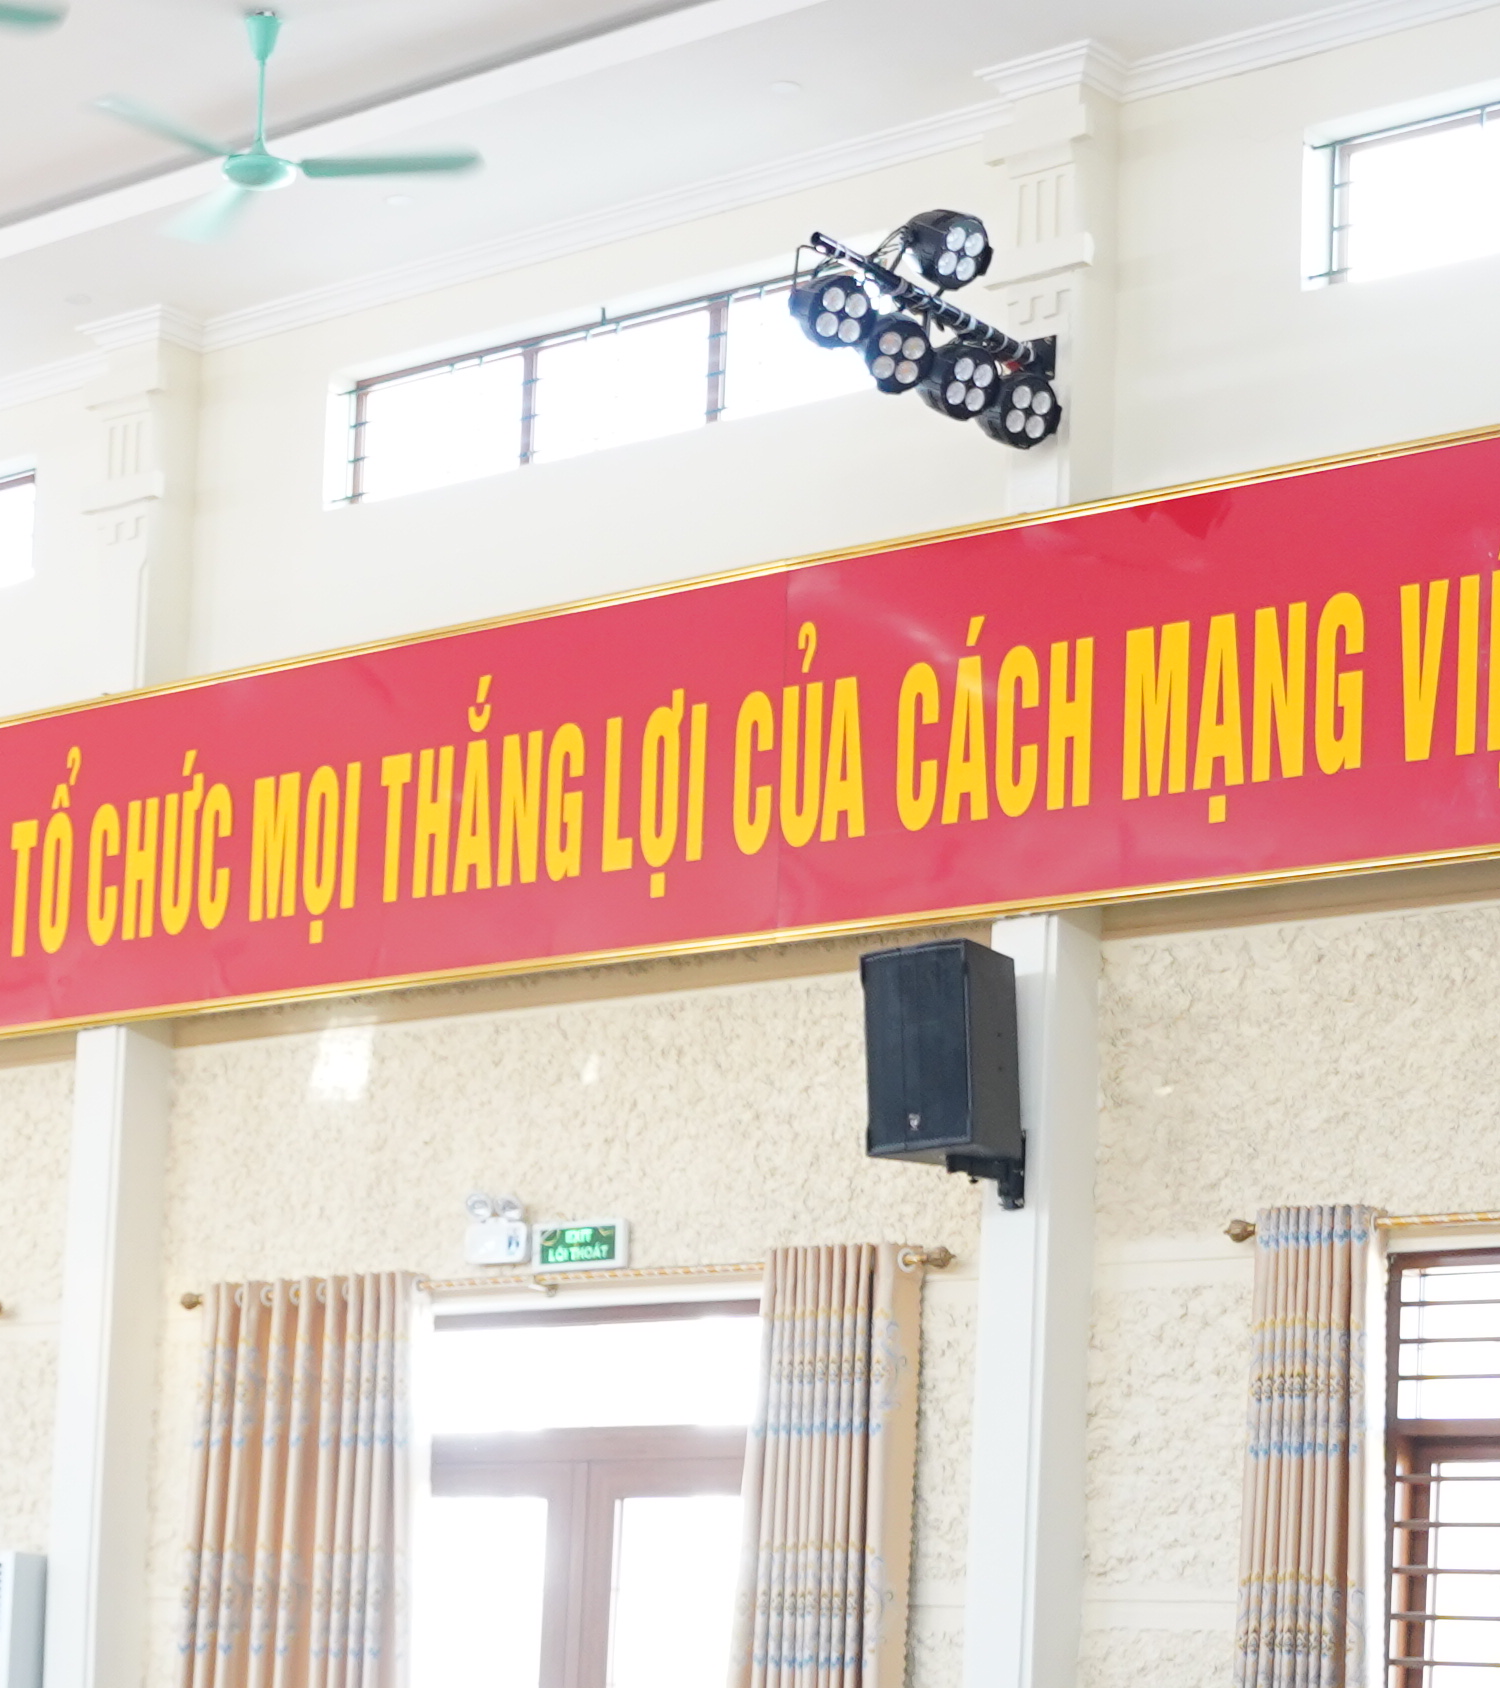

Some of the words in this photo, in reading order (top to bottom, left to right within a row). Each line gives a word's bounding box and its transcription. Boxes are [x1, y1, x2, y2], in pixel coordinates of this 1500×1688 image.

[10, 746, 82, 958] TỔ
[86, 749, 233, 947] CHỨC
[248, 761, 362, 945] MỌI
[380, 674, 585, 903] THẮNG
[601, 687, 708, 899] LỢI
[732, 621, 866, 855] CỦA
[896, 614, 1095, 832] CÁCH
[1122, 592, 1365, 824] MẠNG
